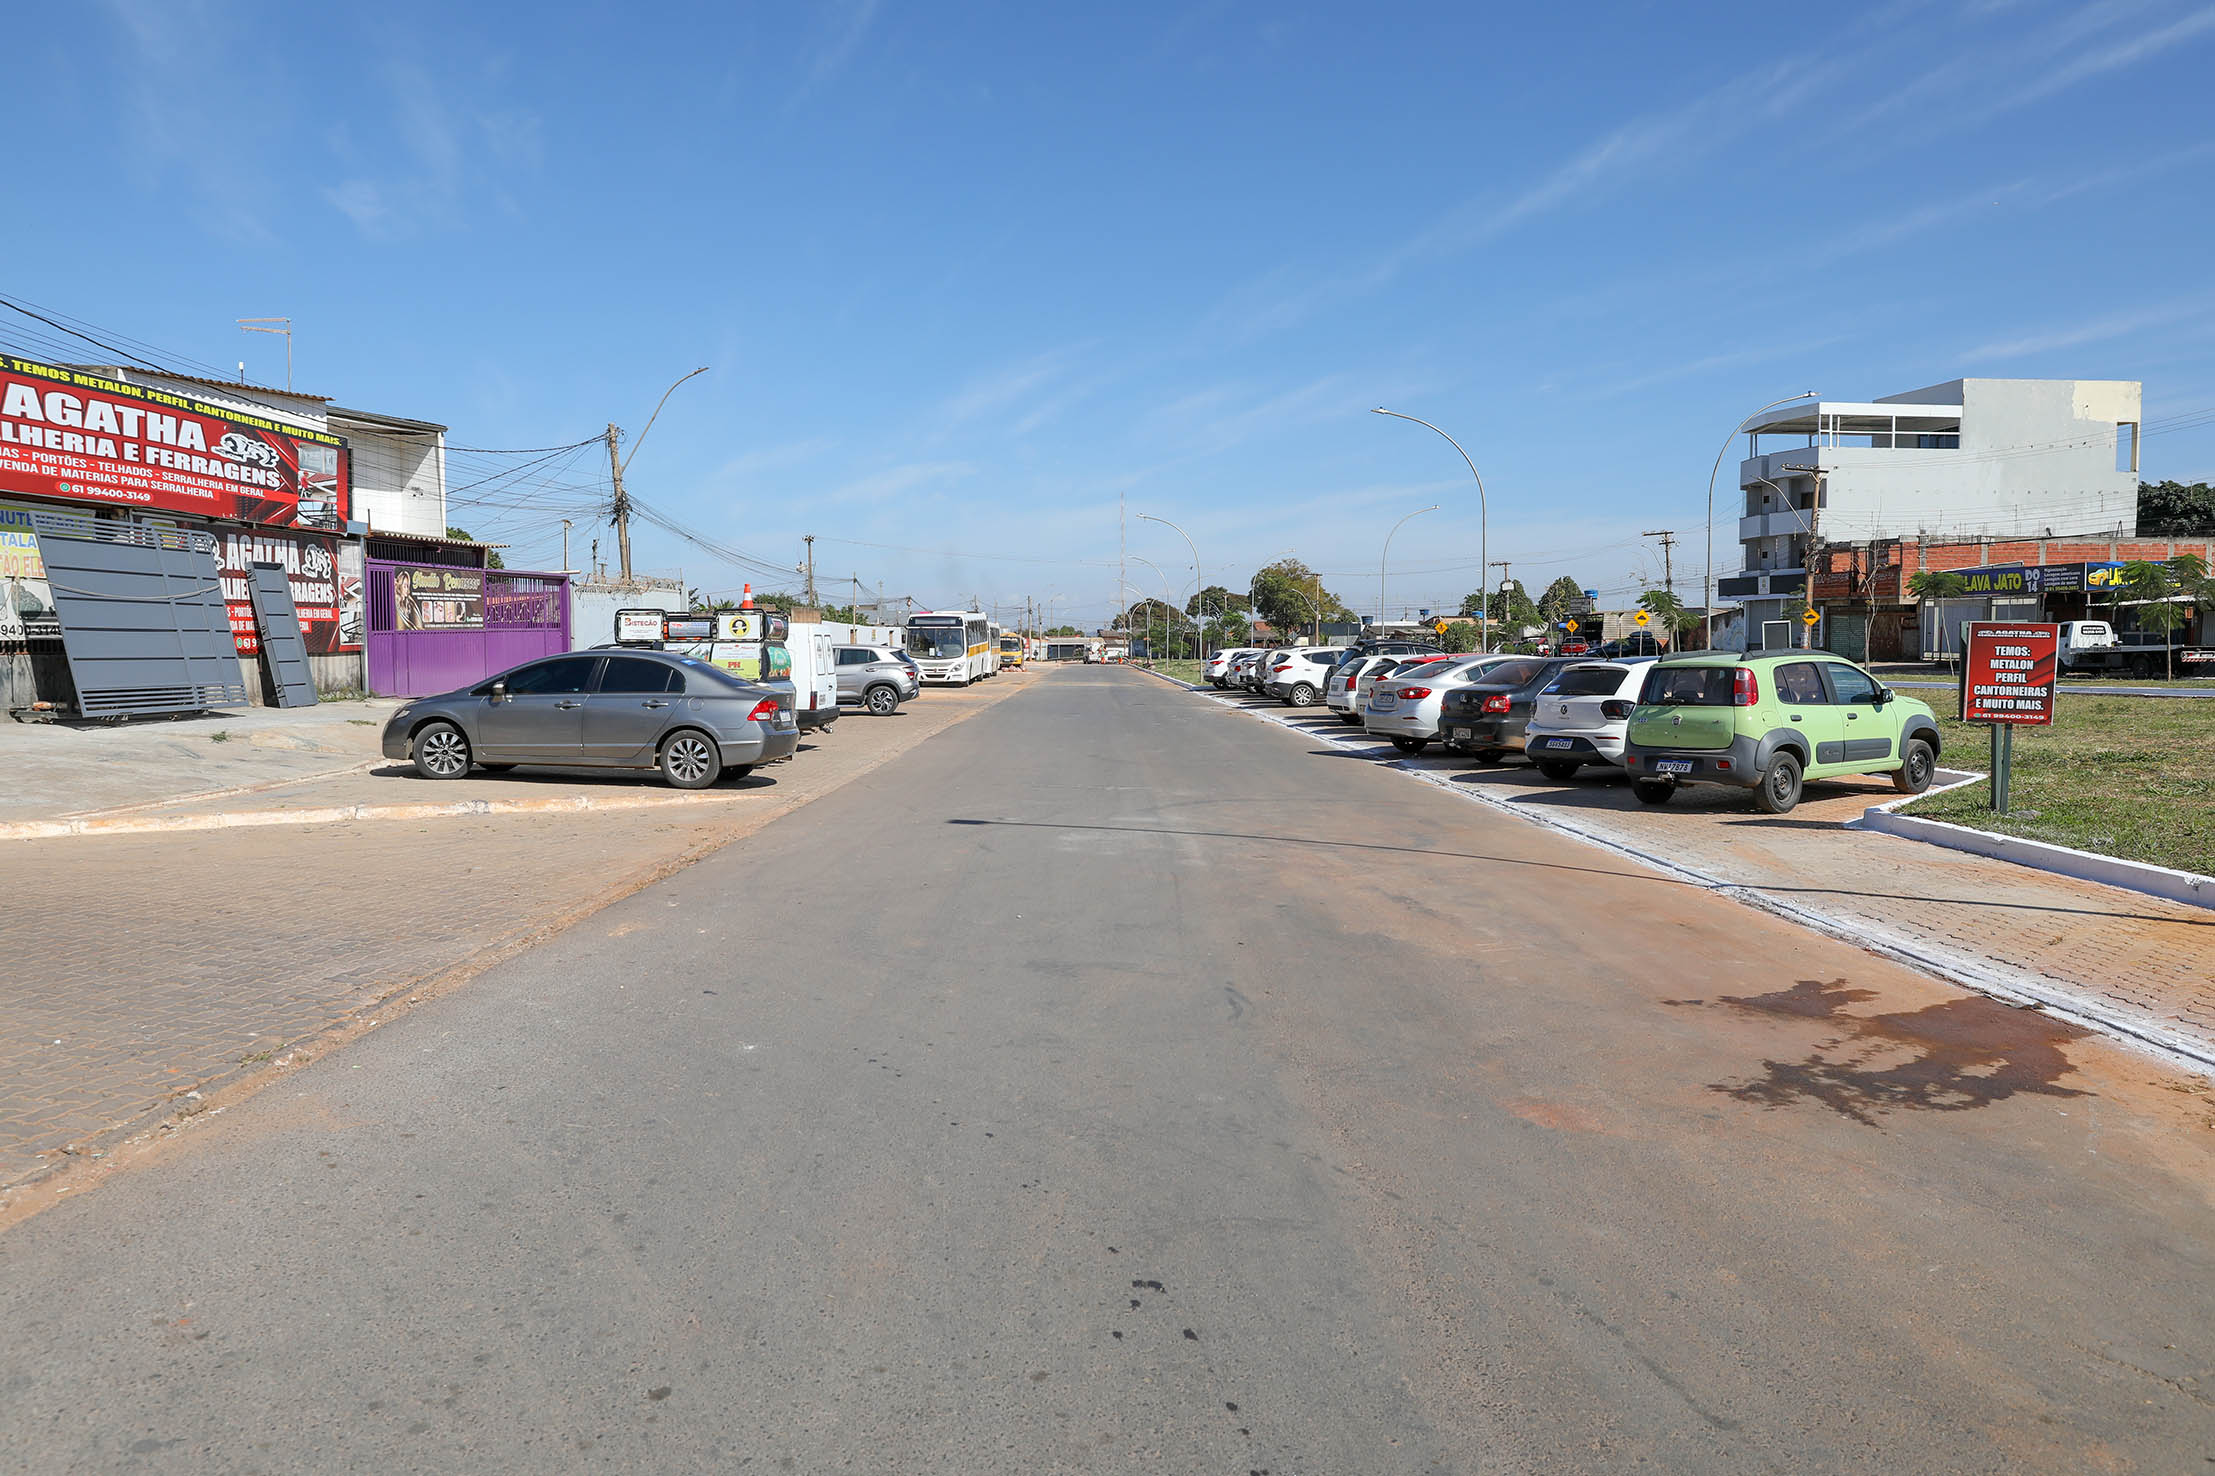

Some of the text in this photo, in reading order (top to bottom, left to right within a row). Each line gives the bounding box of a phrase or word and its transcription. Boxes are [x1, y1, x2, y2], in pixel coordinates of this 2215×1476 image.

[11, 359, 71, 382] TEMOS
[73, 374, 145, 399] METALON,
[194, 402, 272, 430] CANTORNEIRA
[273, 424, 280, 432] E
[281, 425, 313, 440] MUITO
[315, 433, 342, 446] MAIS.
[2, 382, 208, 453] AGATHA
[0, 421, 281, 488] LHERIA E FERRAGENS
[31, 451, 87, 469] PORTÕES
[97, 461, 153, 478] TELHADOS
[162, 471, 224, 490] SERRALHERIA
[225, 483, 238, 493] EM
[240, 486, 265, 498] GERAL
[41, 465, 58, 476] DE
[61, 468, 119, 484] MATERIAS
[121, 476, 149, 489] PARA
[151, 481, 214, 499] SERRALHERIA
[71, 485, 151, 501] 61 99400-3149
[226, 533, 301, 575] AGATHA
[1964, 568, 2040, 592] LAVA JATO DO
[2026, 580, 2038, 593] 14
[1994, 646, 2031, 656] TEMOS:
[1990, 659, 2034, 670] METALON
[1995, 672, 2027, 683] PERFIL
[1973, 685, 2048, 697] CANTORNEIRAS
[1975, 698, 2044, 710] E MUITO MAIS.
